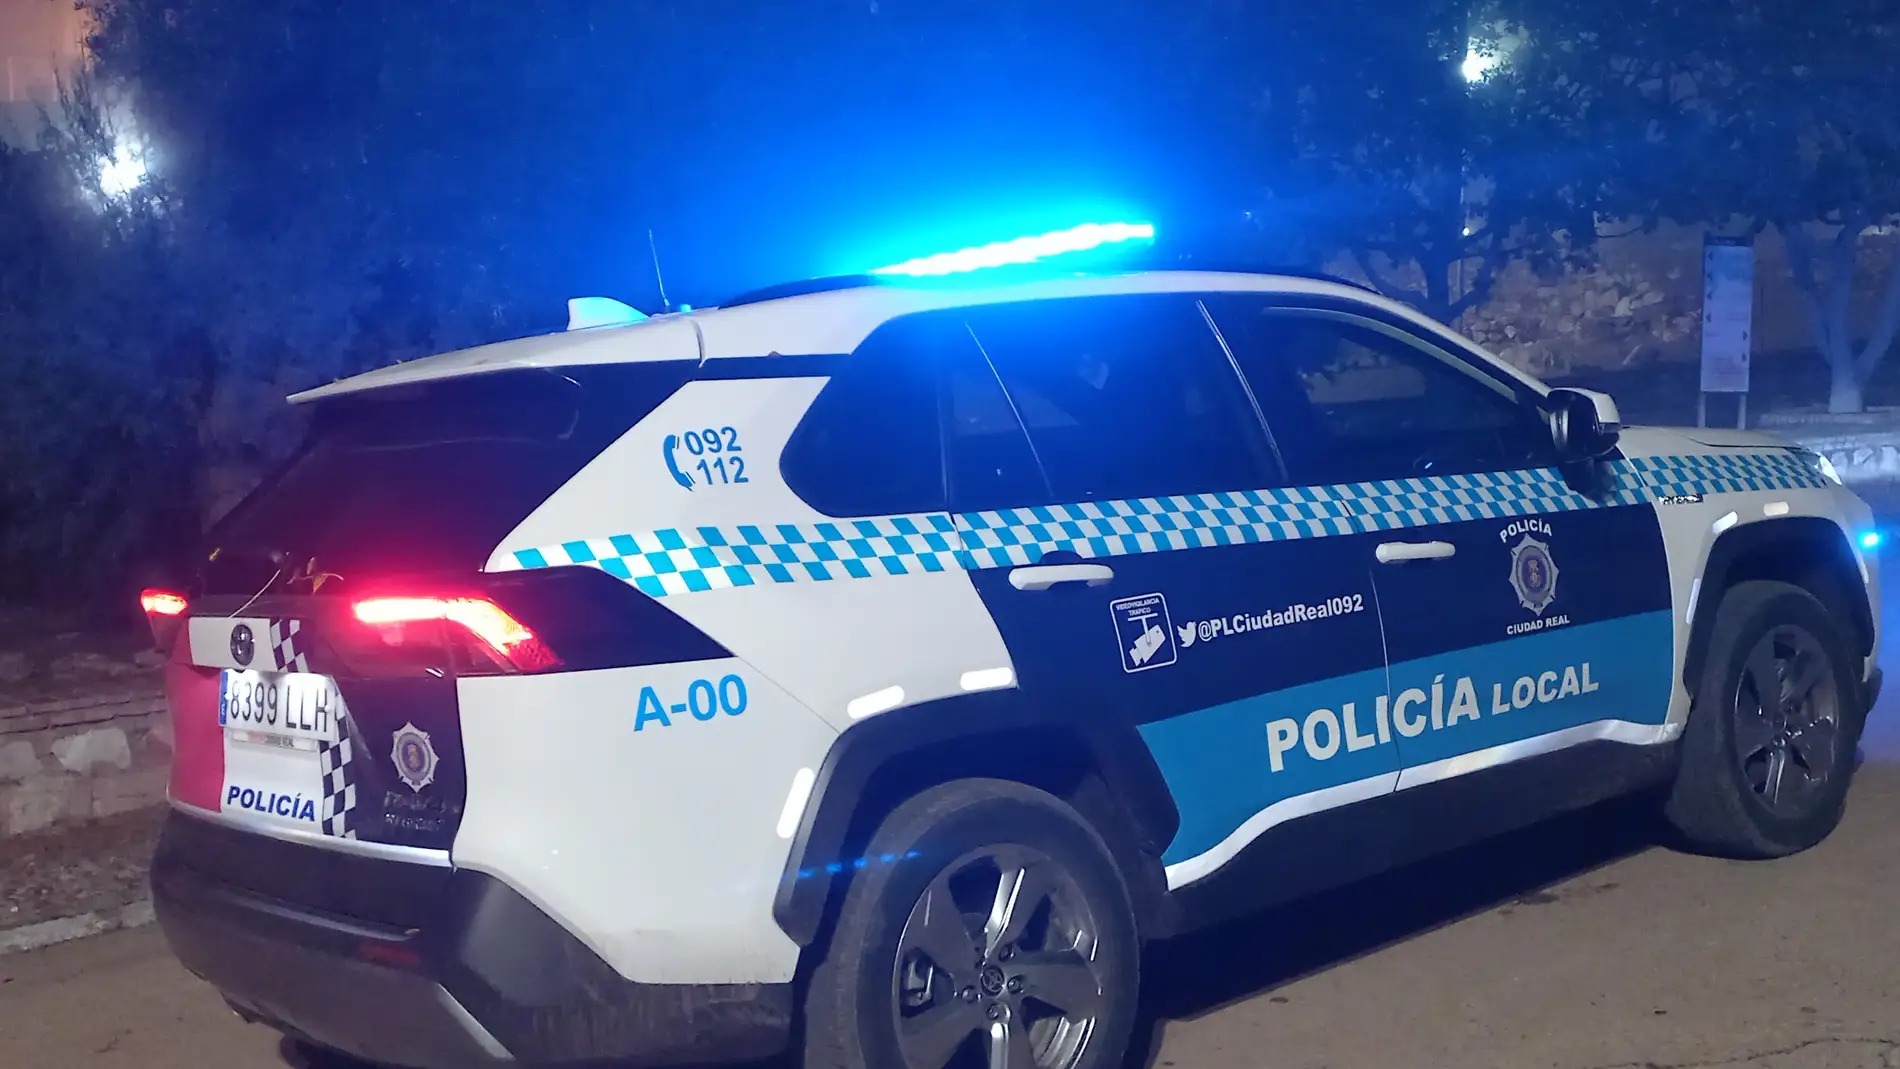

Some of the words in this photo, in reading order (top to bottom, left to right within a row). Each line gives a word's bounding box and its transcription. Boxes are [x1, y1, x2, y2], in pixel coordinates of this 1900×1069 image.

[684, 426, 742, 455] 092
[697, 456, 749, 485] 112
[1499, 518, 1553, 543] POLICÍA
[1198, 593, 1364, 642] @PLCiudadReal092
[1506, 619, 1543, 635] CIUDAD
[1545, 614, 1571, 628] REAL
[230, 680, 278, 726] 8399
[285, 684, 328, 733] LLH
[633, 674, 748, 731] A-00
[1266, 673, 1481, 772] POLICÍA
[1491, 662, 1599, 715] LOCAL
[227, 785, 315, 822] POLICÍA
